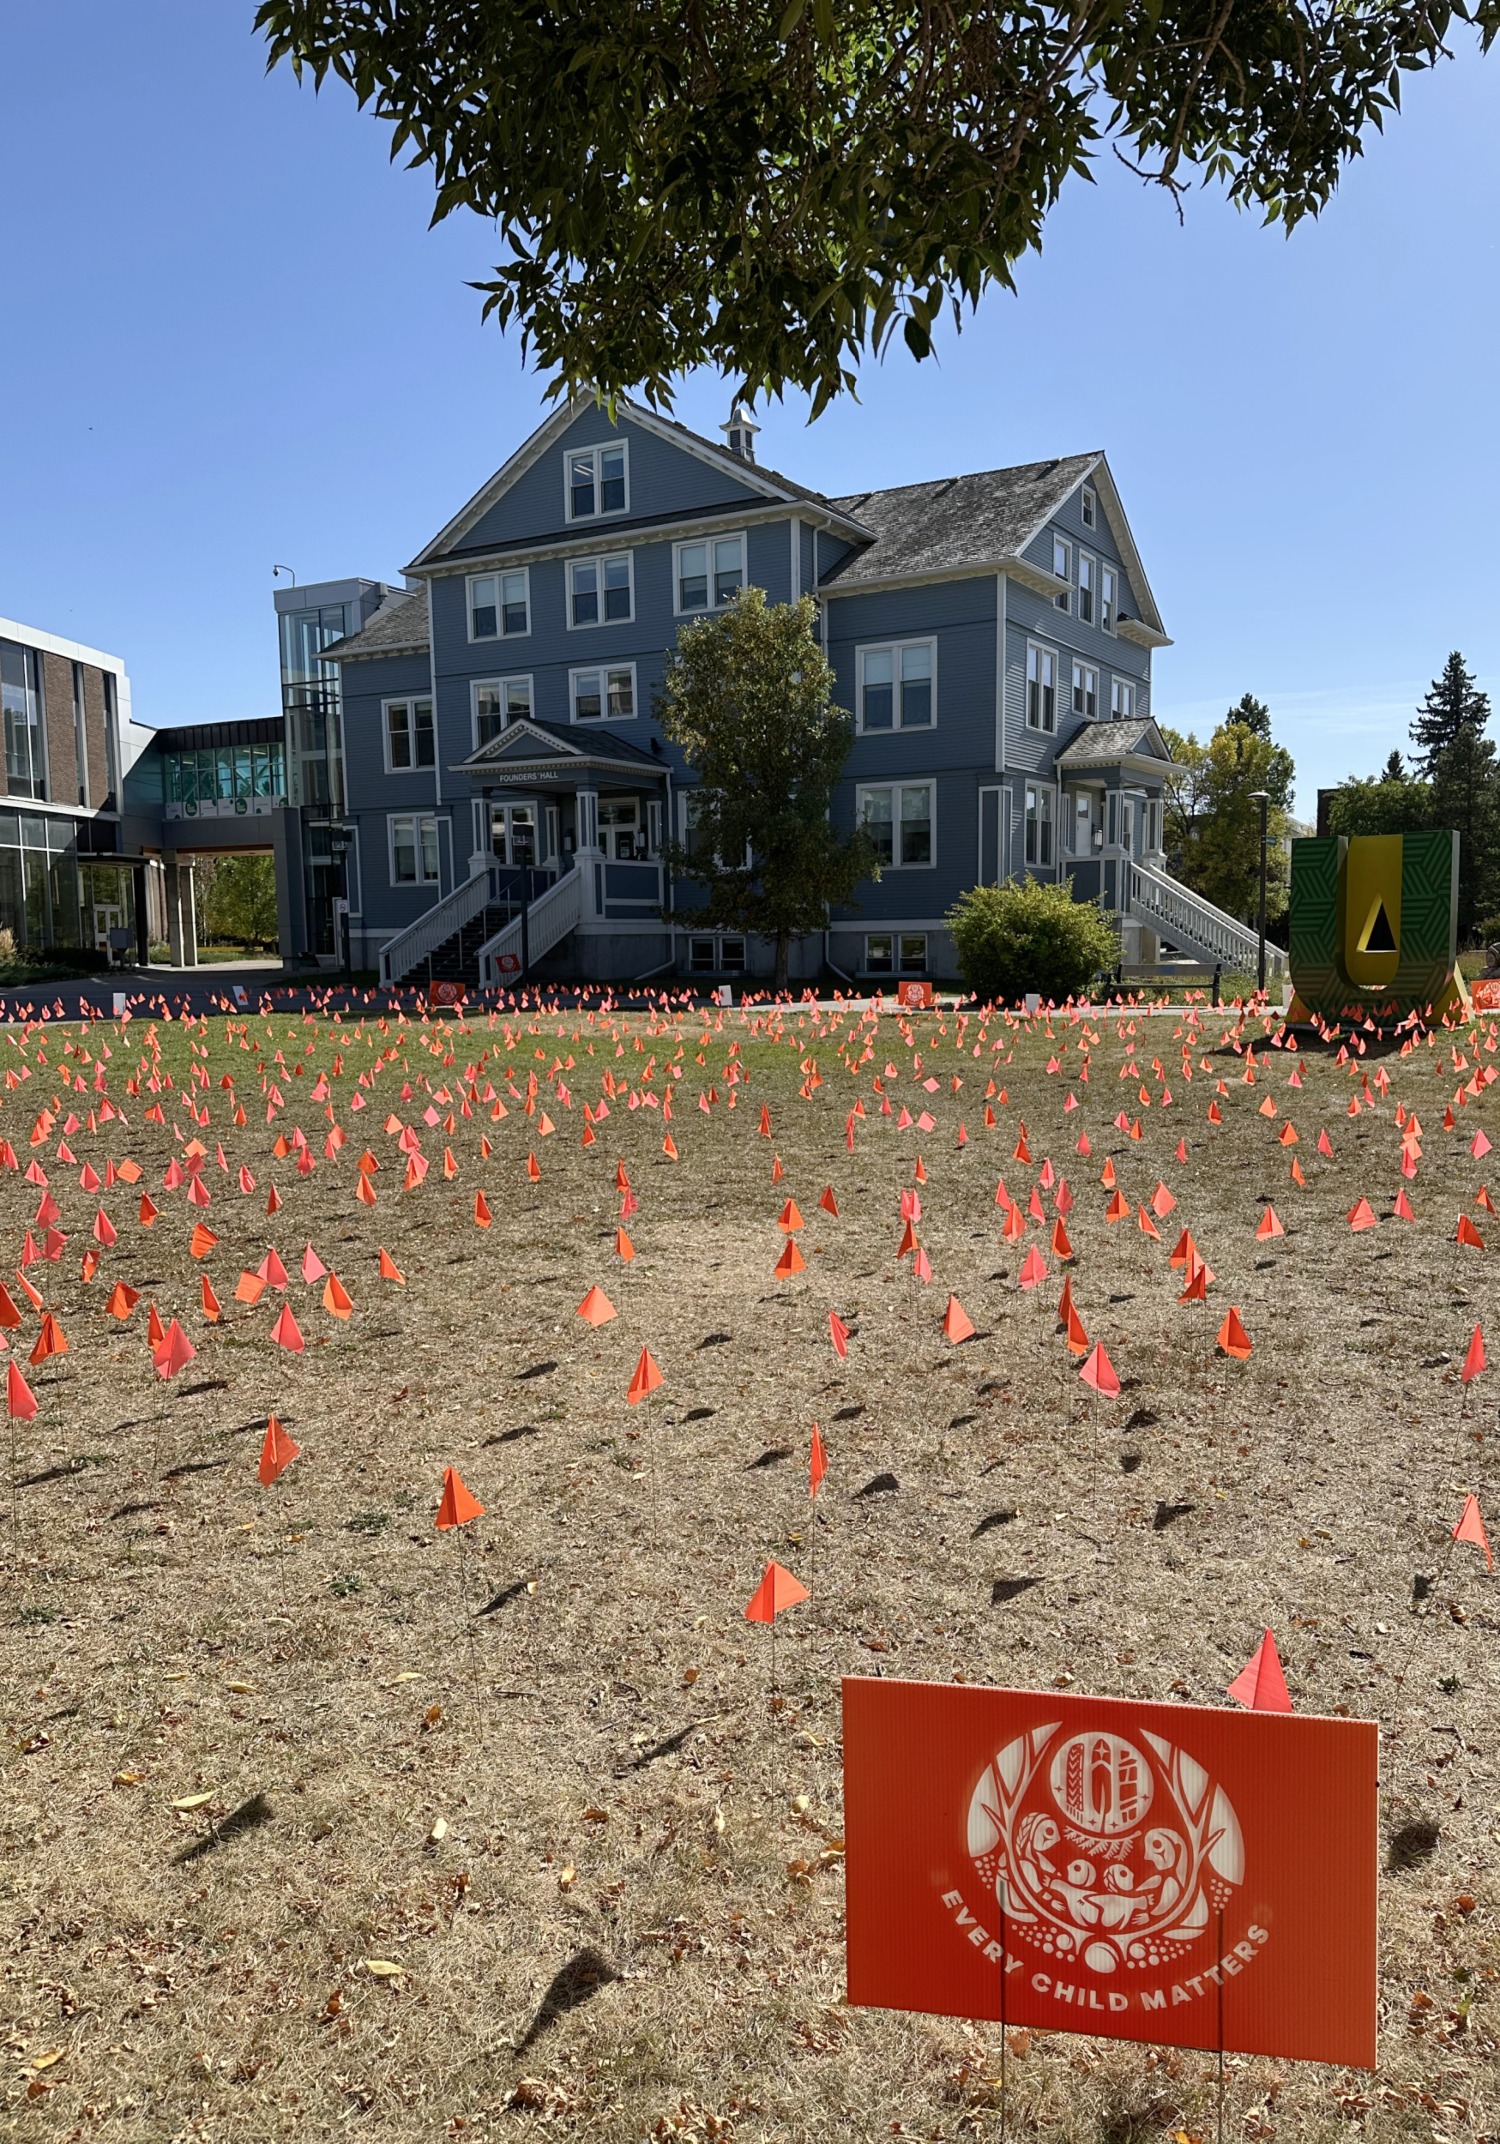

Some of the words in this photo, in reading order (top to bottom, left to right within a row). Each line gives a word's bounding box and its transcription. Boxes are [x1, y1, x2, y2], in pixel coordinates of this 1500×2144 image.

[540, 771, 559, 779] HALL
[941, 1889, 1024, 1974] EVERY
[1031, 1973, 1129, 2011] CHILD
[1140, 1924, 1269, 2011] MATTERS
